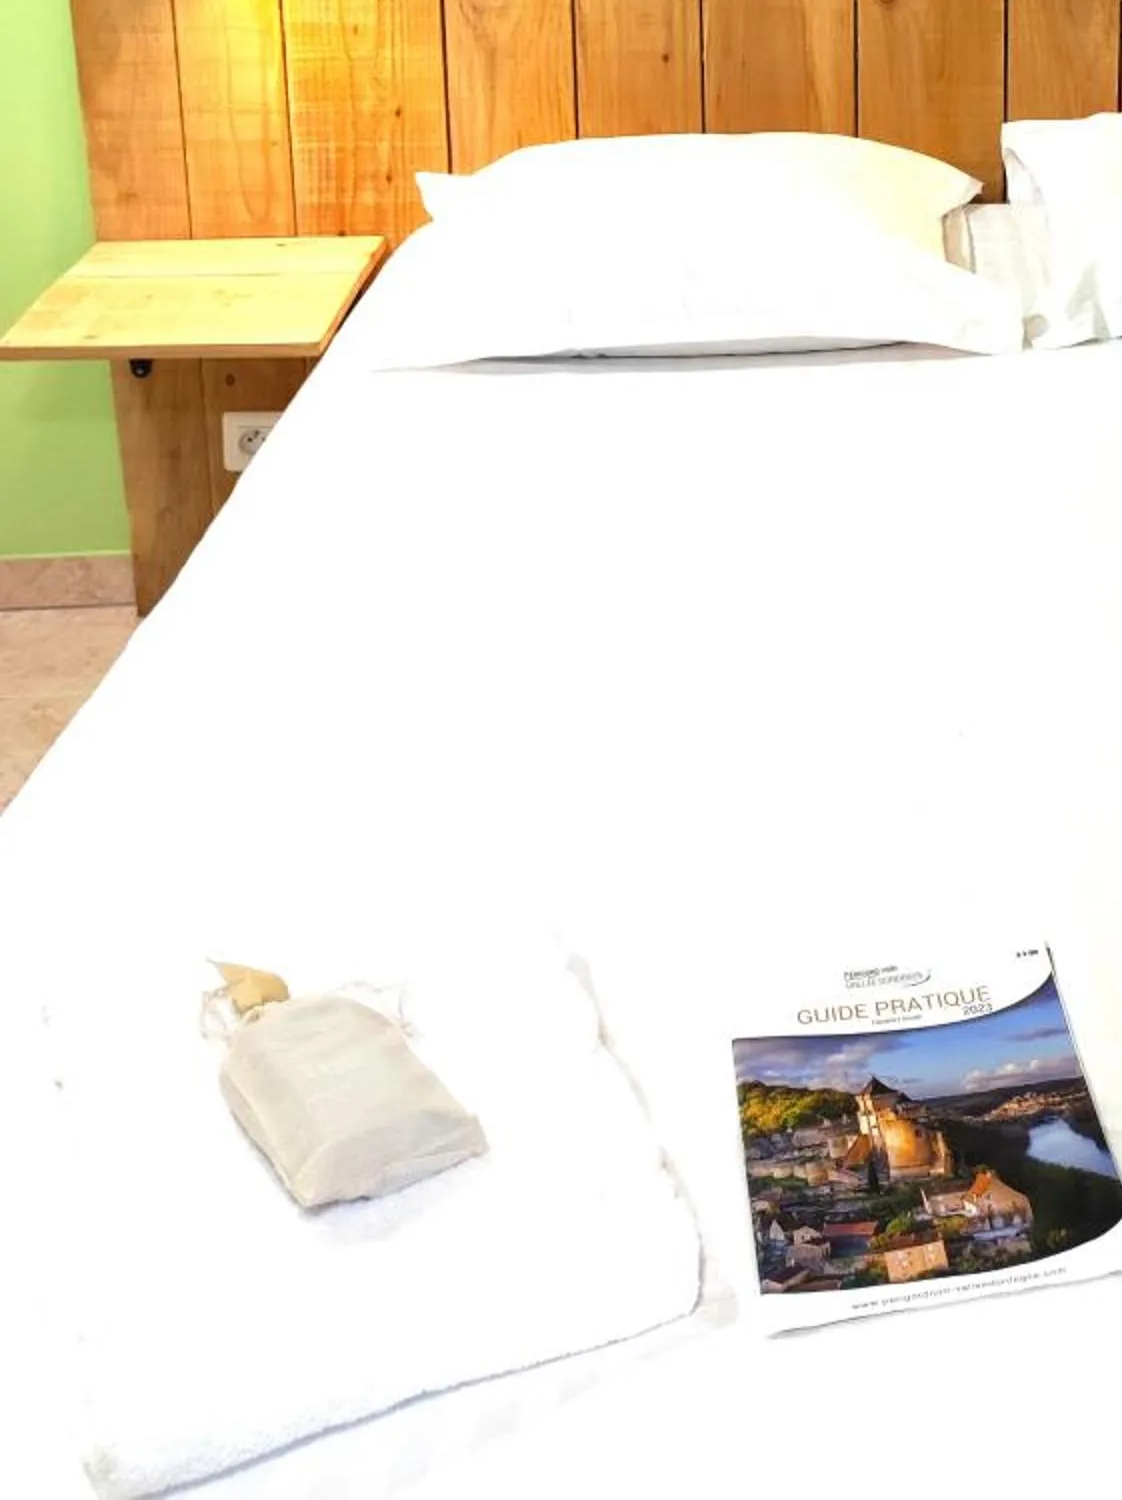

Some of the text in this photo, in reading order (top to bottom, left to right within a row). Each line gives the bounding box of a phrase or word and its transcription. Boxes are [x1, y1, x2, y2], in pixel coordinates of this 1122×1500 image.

[797, 1003, 869, 1025] GUIDE
[875, 986, 992, 1017] PRATIQUE
[963, 1003, 993, 1016] 2023
